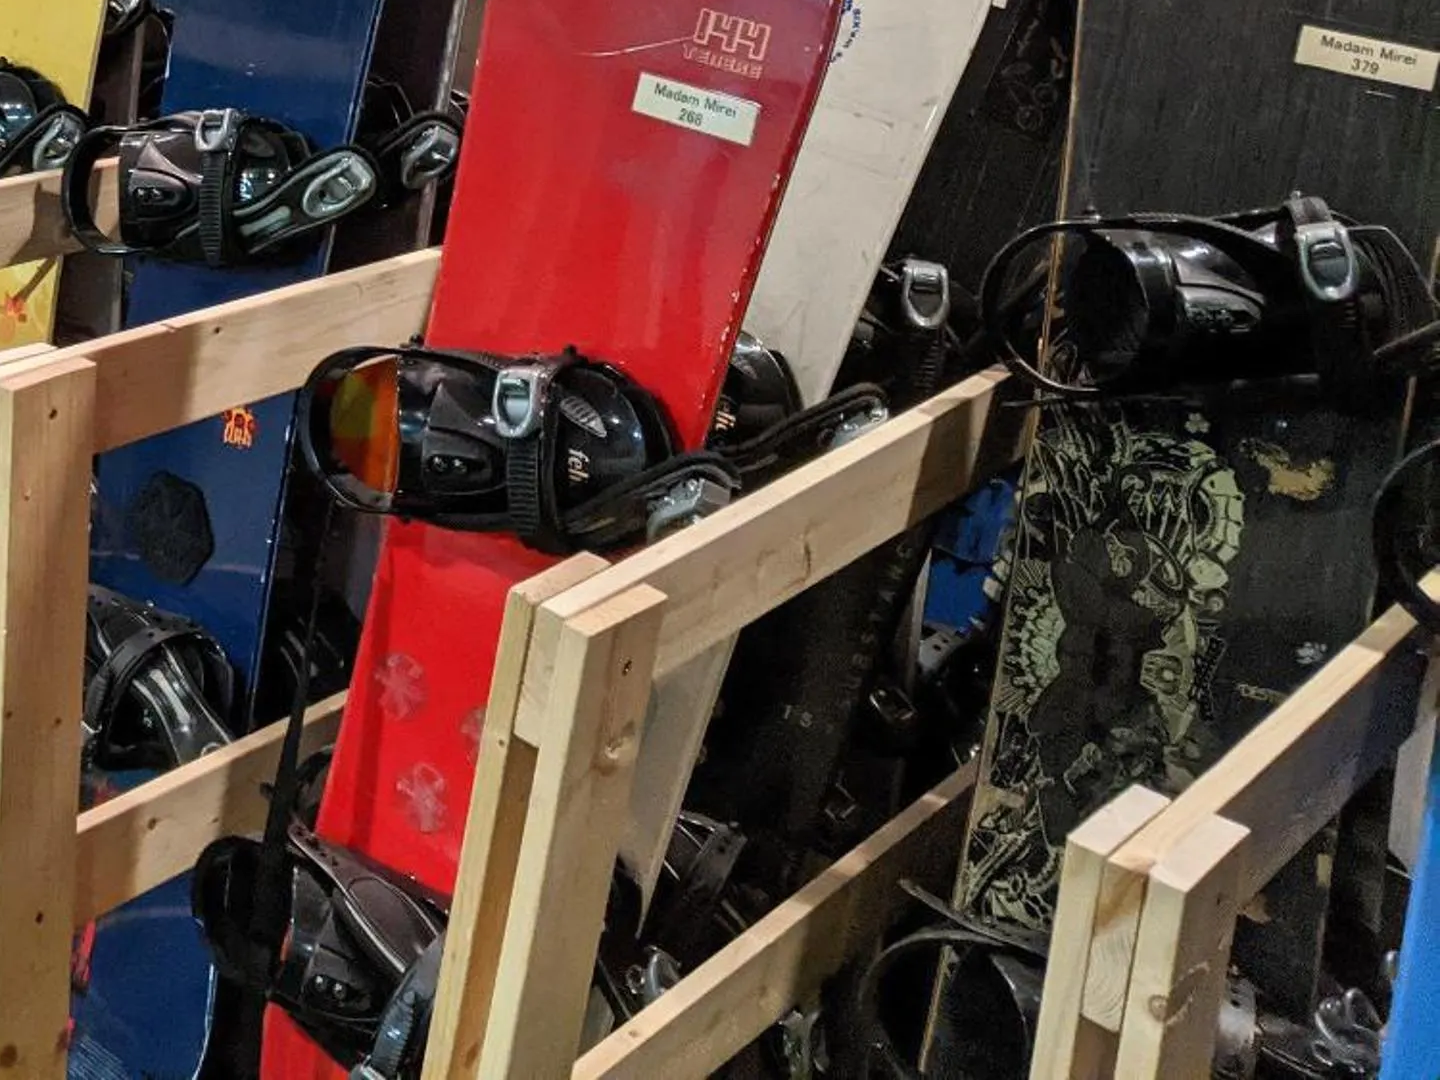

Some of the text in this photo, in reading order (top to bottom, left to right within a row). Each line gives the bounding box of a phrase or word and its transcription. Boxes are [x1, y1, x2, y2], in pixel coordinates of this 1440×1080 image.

[1320, 34, 1418, 65] Madam Mirei
[1351, 58, 1380, 74] 379
[653, 82, 737, 119] Madam Mirei
[678, 107, 704, 127] 268
